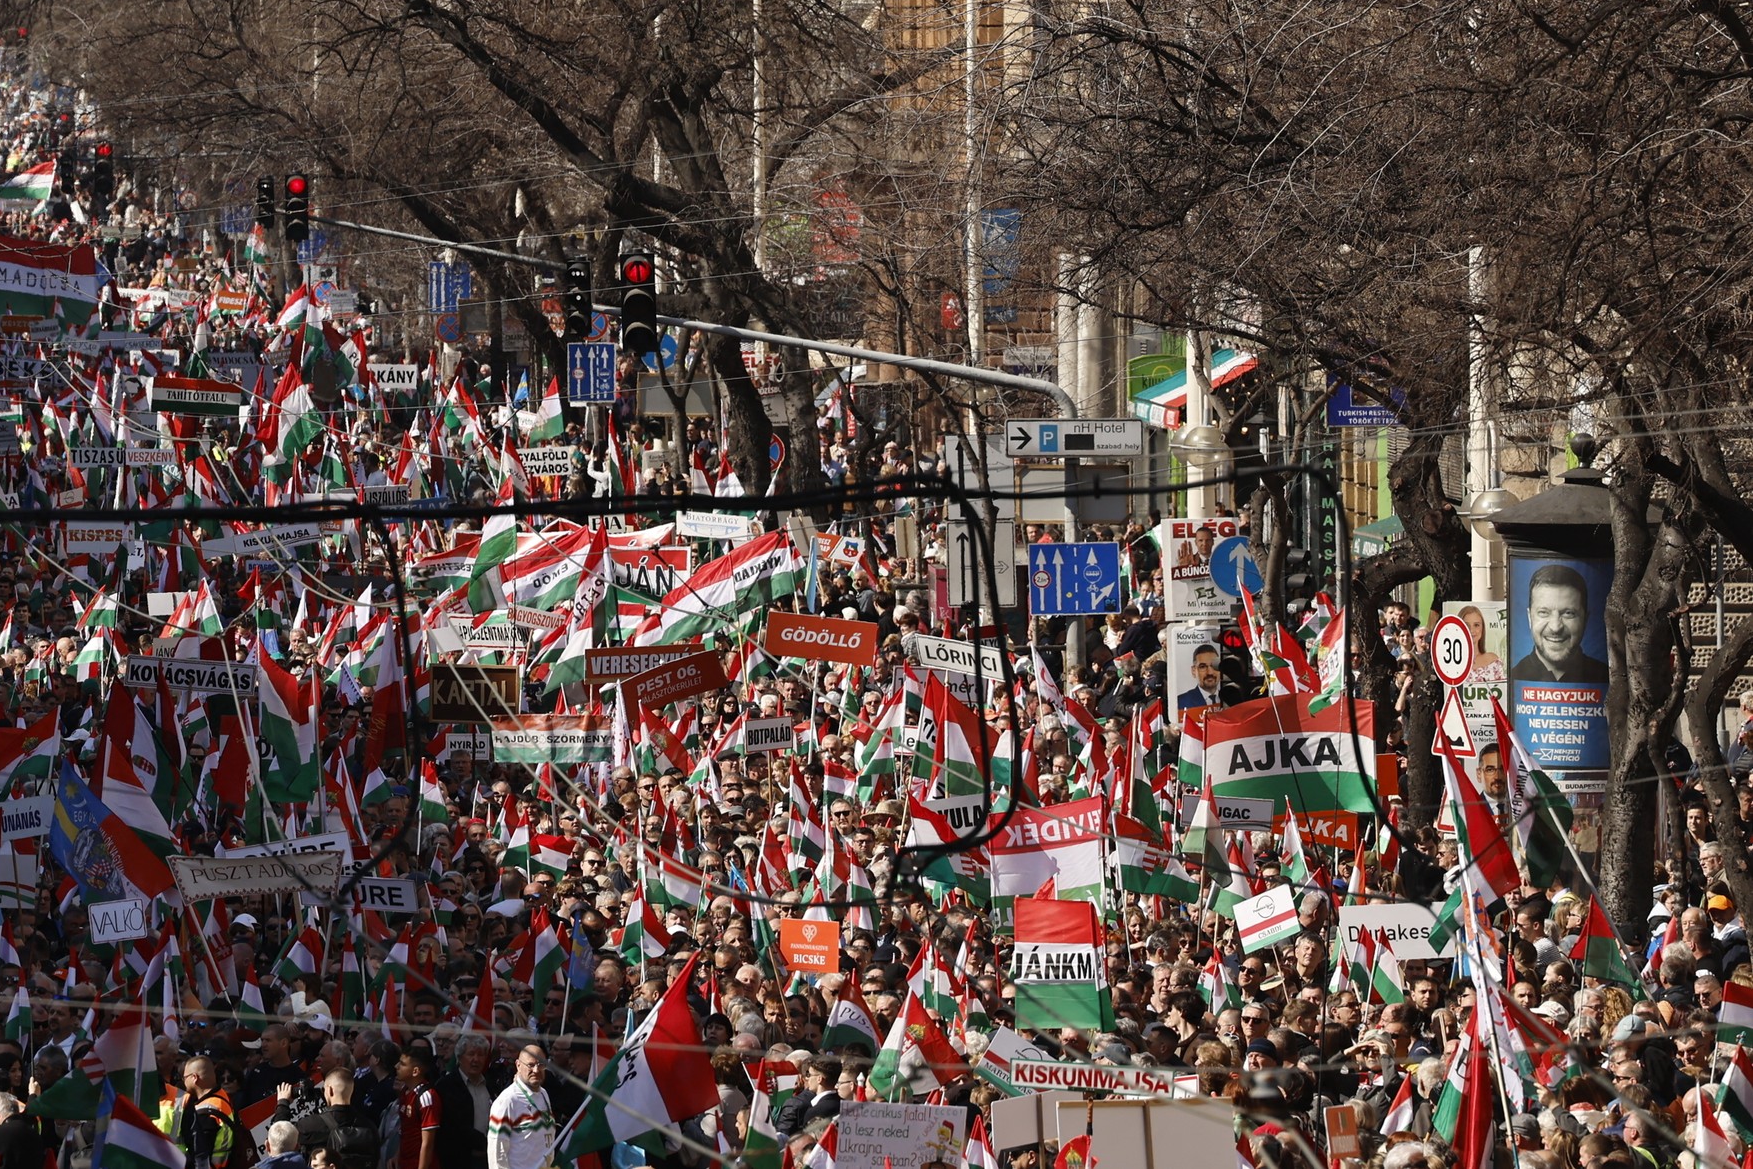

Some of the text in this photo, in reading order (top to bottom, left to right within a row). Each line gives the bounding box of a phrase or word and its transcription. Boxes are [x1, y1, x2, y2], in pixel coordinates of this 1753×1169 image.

[1338, 410, 1367, 418] TURKISH
[1073, 423, 1126, 434] nH Hotel
[1096, 442, 1141, 452] szabad hely
[127, 448, 174, 463] VESZKÉNY
[686, 512, 740, 525] BIATORBÁGY
[243, 528, 310, 548] KISKUMAJSA
[1187, 599, 1226, 608] Mi Hazánk
[780, 627, 862, 649] GÖDÖLLŐ
[1177, 631, 1205, 641] Kovács
[924, 644, 998, 672] LŐRINCI
[1443, 638, 1462, 665] 30
[128, 662, 251, 690] KOVÁCSVÁGÁS
[637, 664, 702, 696] PEST 06.
[432, 678, 515, 707] KARTAL
[1523, 689, 1600, 704] NE HAGYJUK,
[1516, 704, 1537, 716] HOGY
[1528, 718, 1589, 731] NEVESSEN
[747, 723, 792, 746] BOTPALÁD
[1530, 731, 1586, 745] A VÉGÉN!
[1228, 736, 1343, 776] AJKA
[1552, 754, 1581, 762] PETÍCIÓ
[1565, 782, 1601, 790] BUDAPEST
[91, 901, 144, 936] VALKÓ
[792, 953, 826, 966] BICSKE
[1014, 1063, 1170, 1094] KISKUNMAJSA
[855, 1123, 875, 1138] lesz
[877, 1124, 910, 1140] neked
[838, 1138, 883, 1158] Ukrajna
